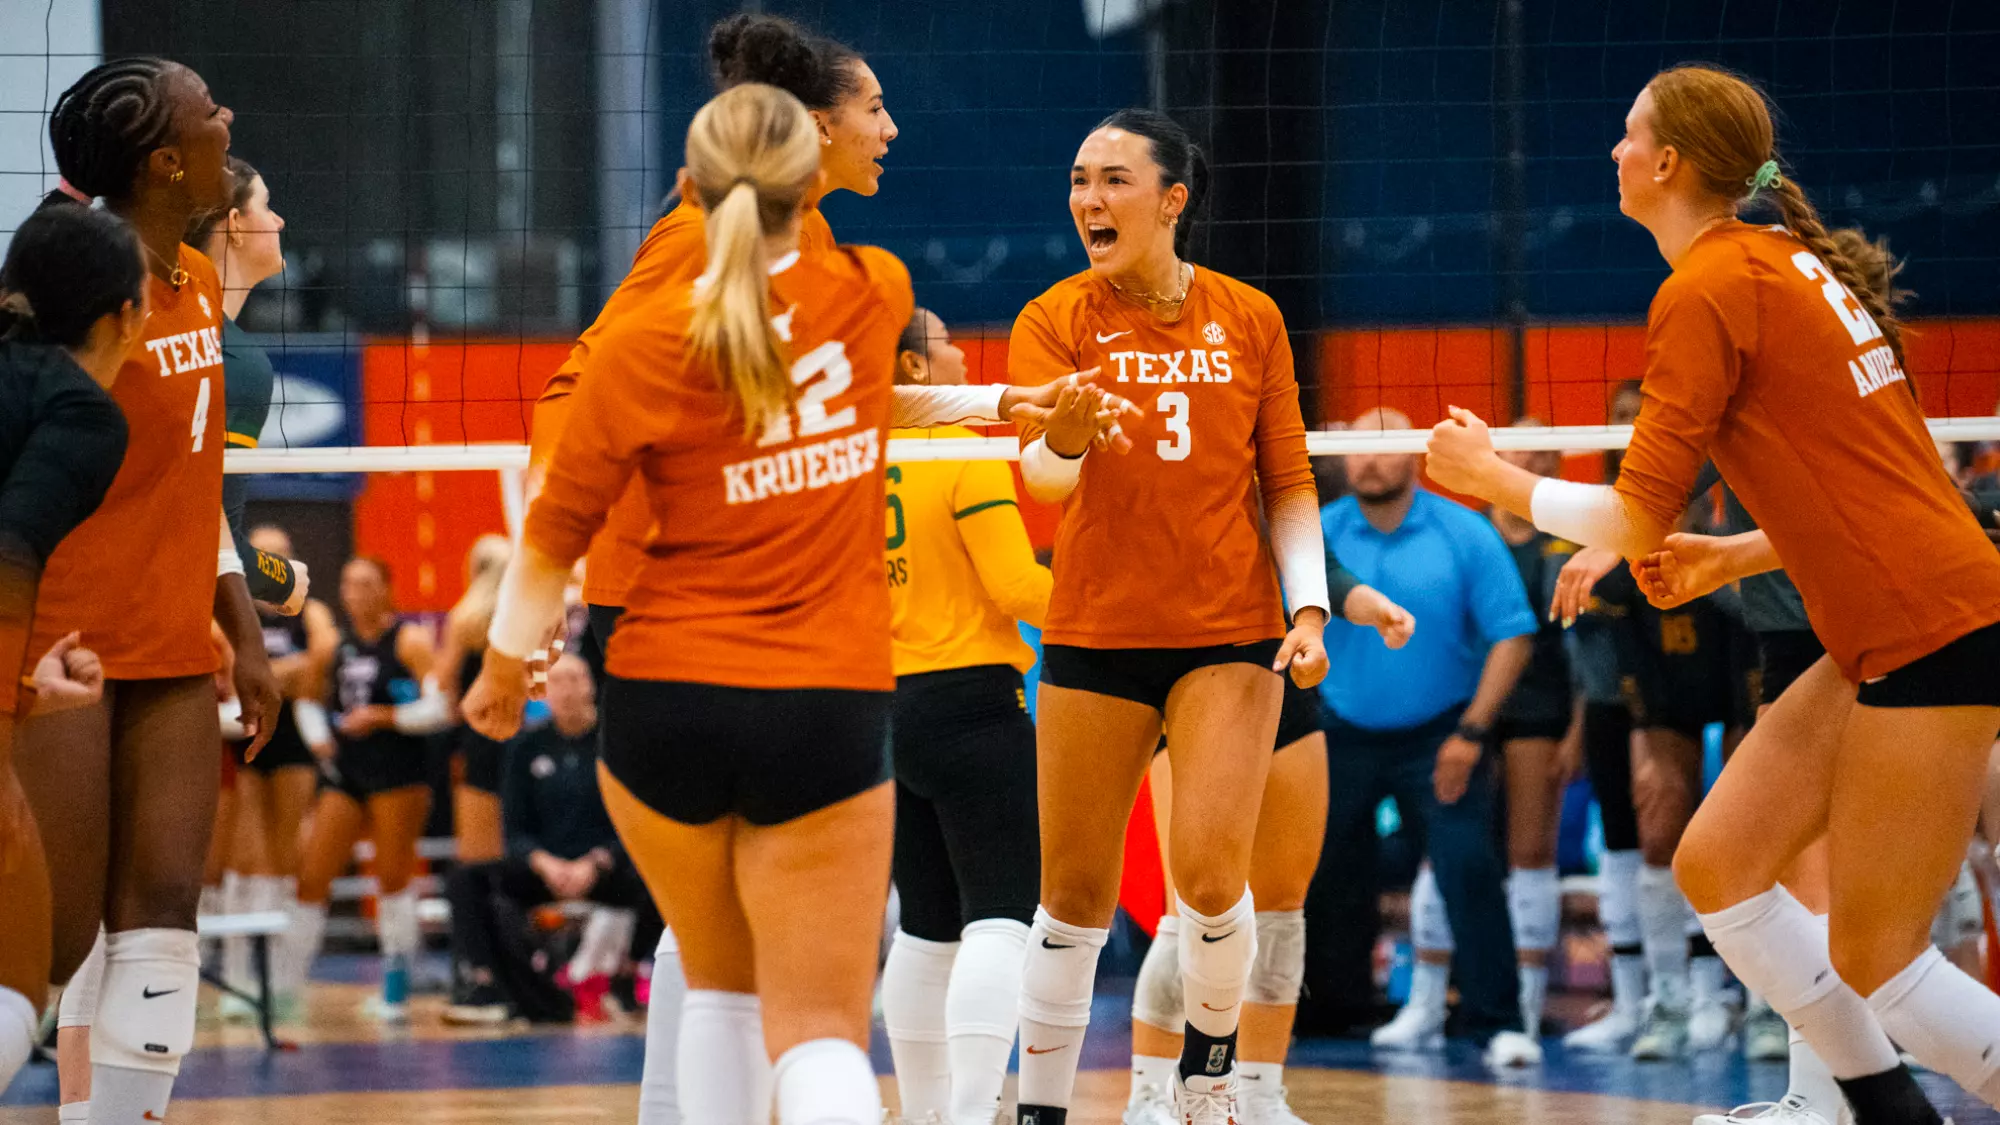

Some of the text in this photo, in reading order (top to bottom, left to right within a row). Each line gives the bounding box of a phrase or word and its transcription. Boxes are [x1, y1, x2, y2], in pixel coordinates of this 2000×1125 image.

[1790, 251, 1883, 346] 2
[1203, 322, 1225, 345] SEC
[1110, 349, 1232, 384] TEXAS
[1848, 345, 1906, 397] ANDE
[191, 377, 211, 452] 4
[1156, 391, 1191, 461] 3
